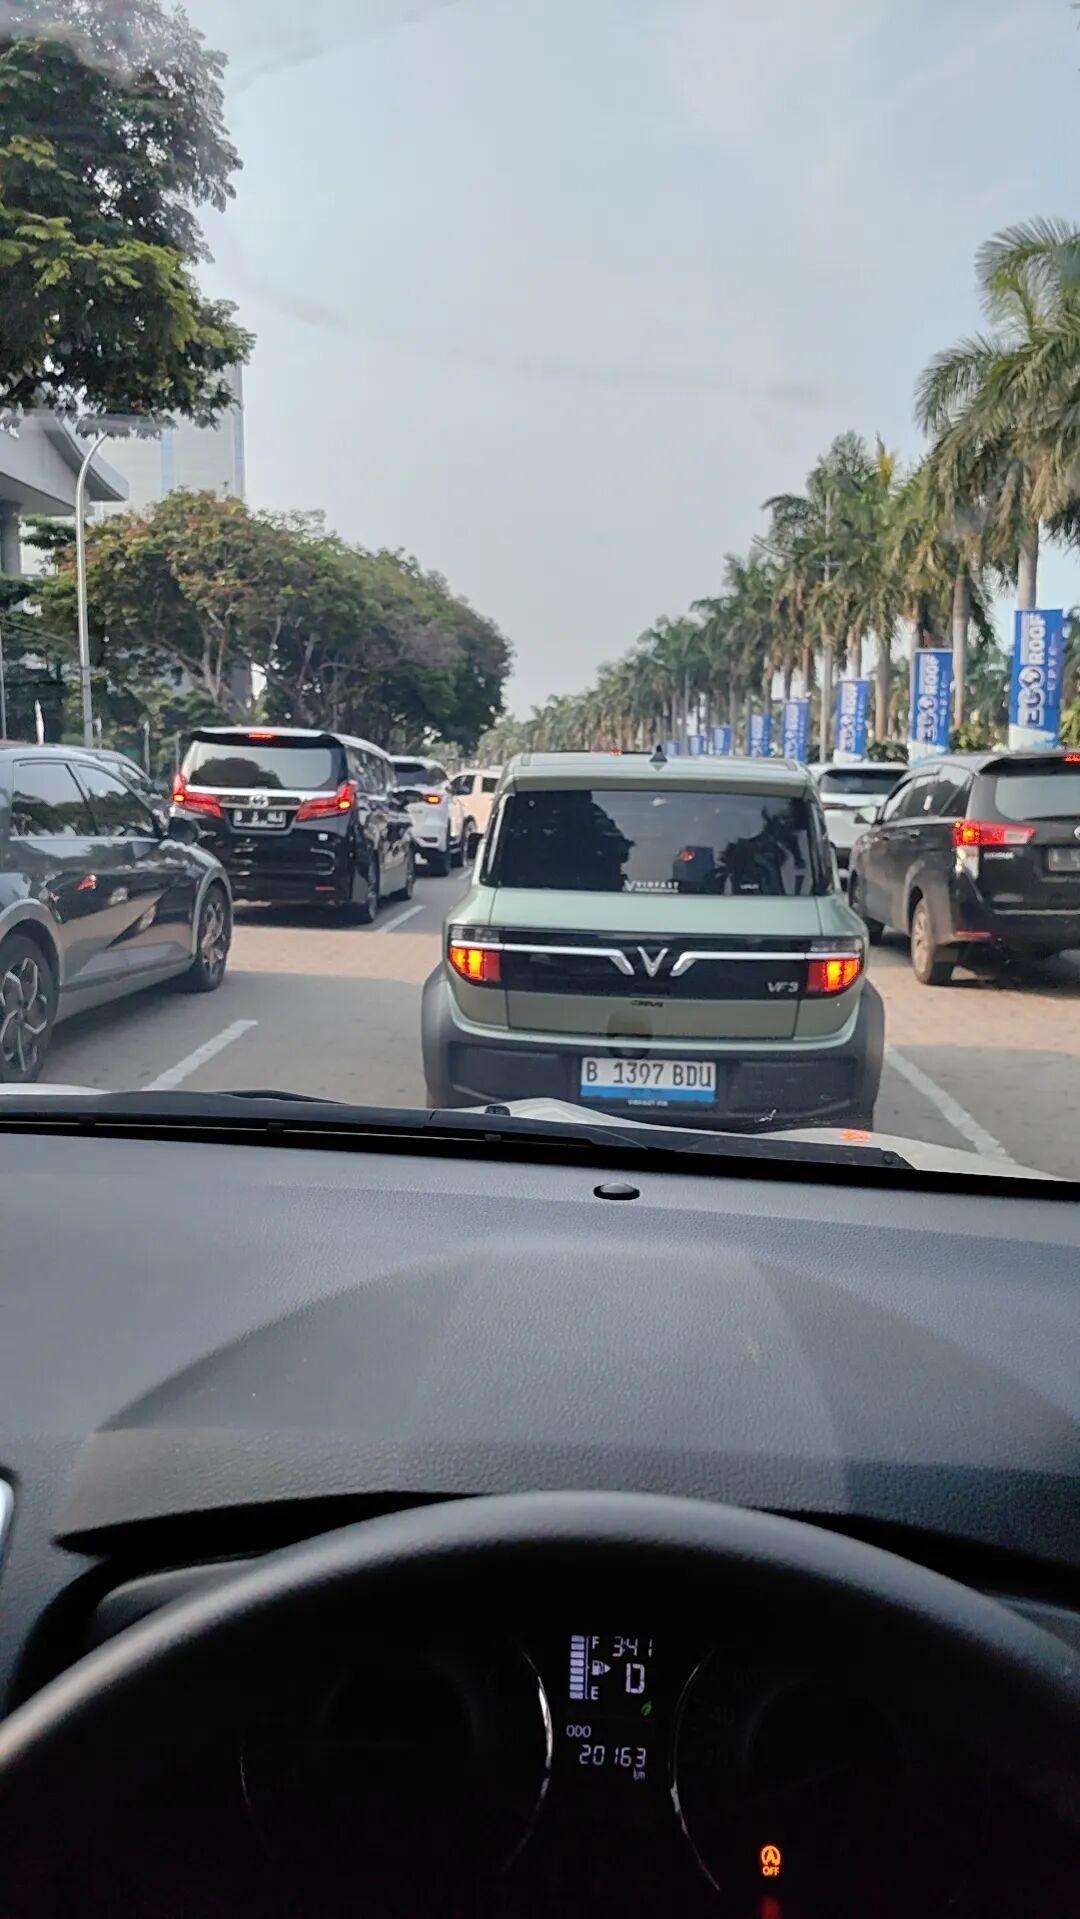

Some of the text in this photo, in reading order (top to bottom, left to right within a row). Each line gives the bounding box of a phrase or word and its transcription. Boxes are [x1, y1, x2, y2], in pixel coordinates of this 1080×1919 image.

[1028, 613, 1046, 665] ROOF
[587, 1060, 712, 1087] B 1397 BDU
[591, 1636, 600, 1649] F
[625, 1662, 645, 1694] D
[590, 1686, 599, 1700] E
[566, 1725, 592, 1738] ODO
[579, 1744, 647, 1768] 20163
[633, 1769, 646, 1780] km
[762, 1866, 780, 1877] OFF
